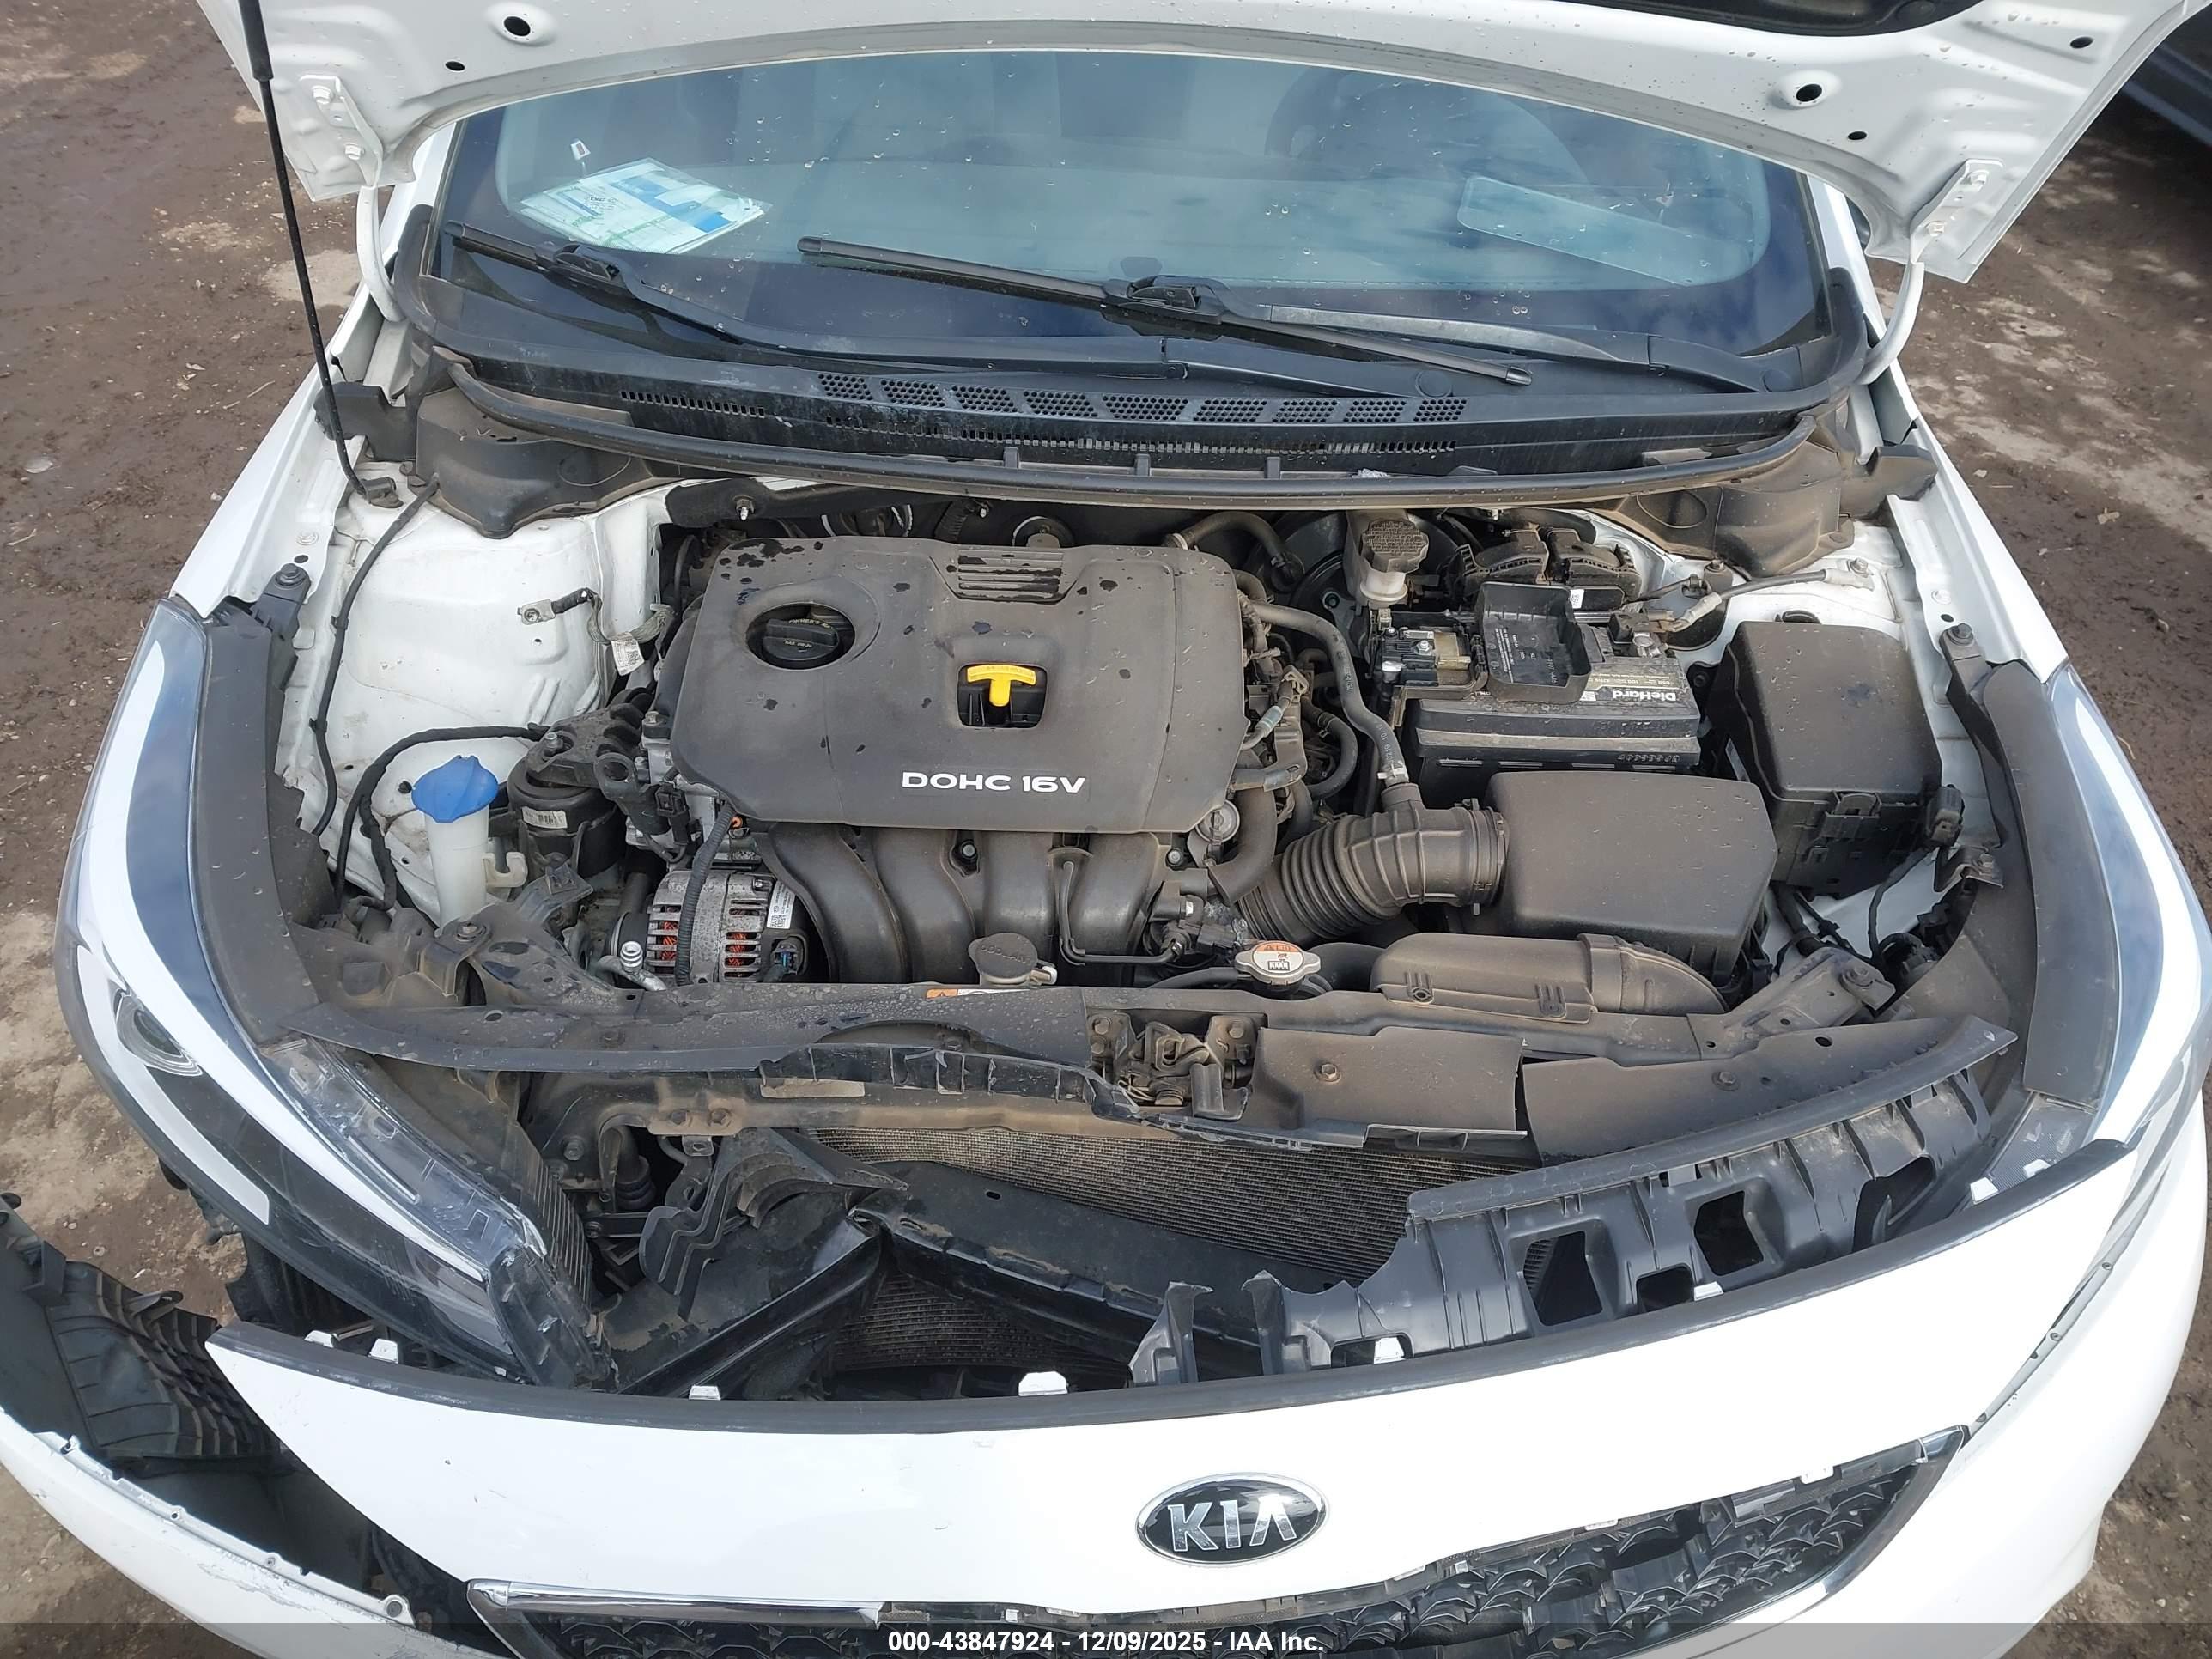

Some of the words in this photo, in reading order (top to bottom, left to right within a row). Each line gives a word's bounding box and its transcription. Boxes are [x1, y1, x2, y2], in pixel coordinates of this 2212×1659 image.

[1612, 690, 1677, 702] DieHard
[902, 772, 1012, 792] DOHC
[1022, 775, 1086, 793] 16V
[1167, 1493, 1297, 1552] KIA
